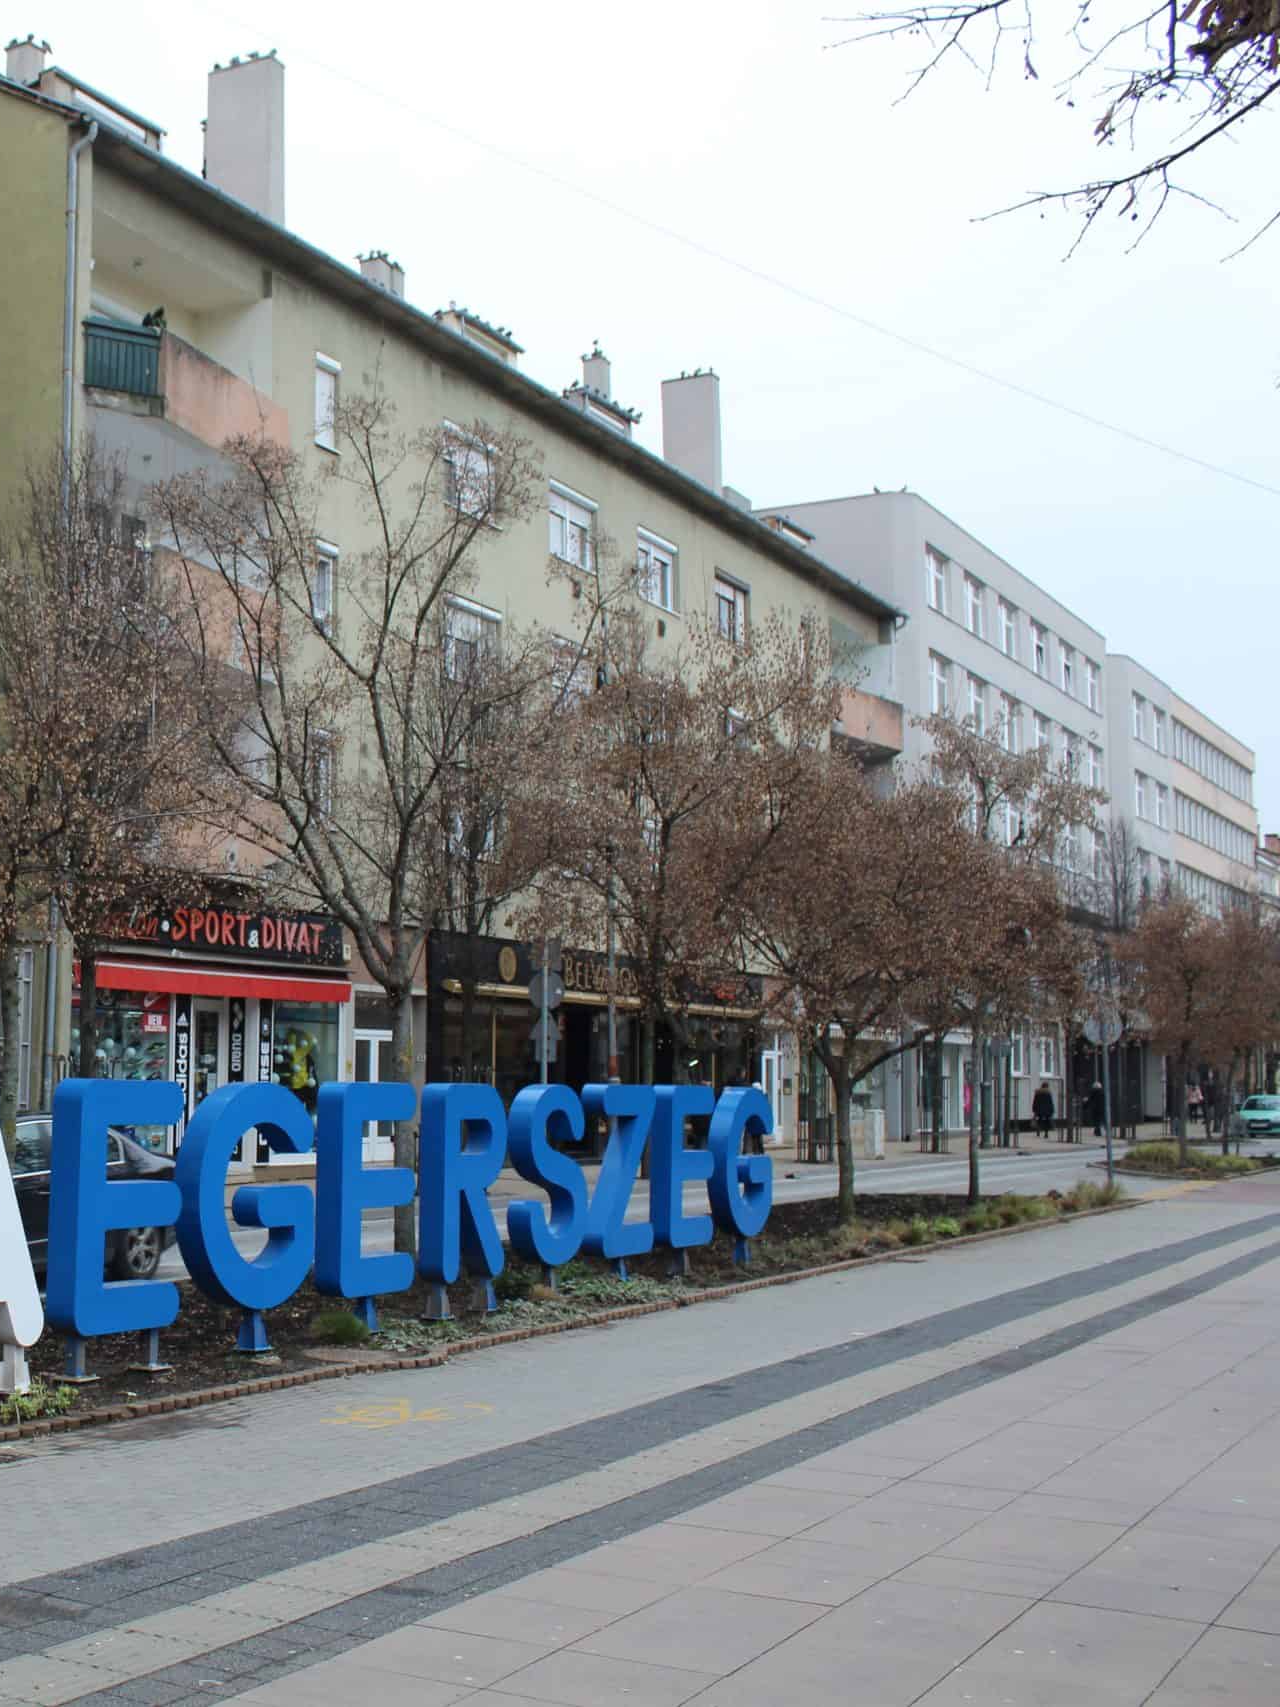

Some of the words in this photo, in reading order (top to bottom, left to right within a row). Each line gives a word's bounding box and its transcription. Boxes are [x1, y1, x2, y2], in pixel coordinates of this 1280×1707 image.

[172, 908, 250, 947] SPORT
[248, 930, 259, 948] &
[262, 916, 325, 955] DIVAT
